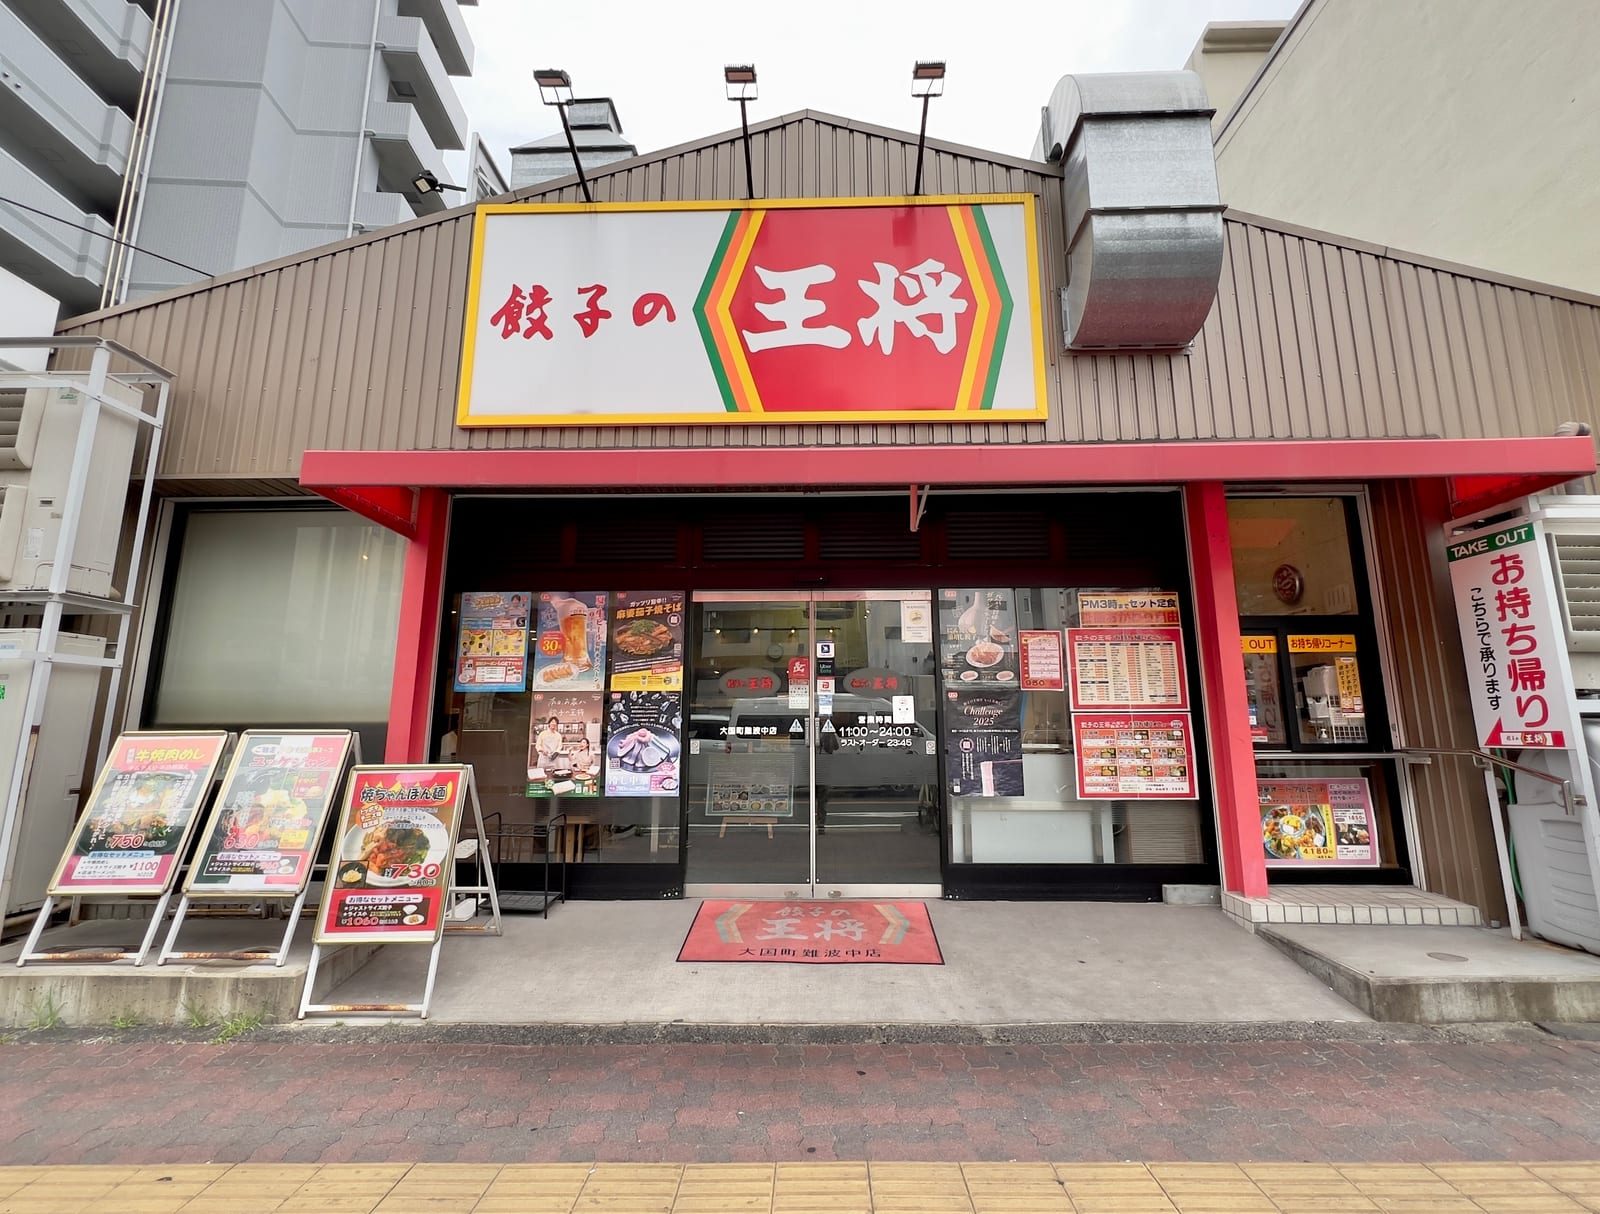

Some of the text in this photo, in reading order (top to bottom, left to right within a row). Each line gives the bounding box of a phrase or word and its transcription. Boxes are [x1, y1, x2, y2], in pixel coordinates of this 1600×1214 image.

[490, 257, 969, 356] 餃子の 王将
[1451, 527, 1529, 559] TAKE OUT
[1291, 638, 1352, 649] お持ち帰りコーナー
[1490, 553, 1550, 728] お持ち帰り
[1470, 587, 1502, 711] こちらで承ります
[963, 706, 1004, 718] Challenge
[858, 715, 893, 724] 営業時間
[973, 717, 995, 726] 2025
[720, 726, 777, 735] 大国町難波中店
[136, 748, 205, 762] 牛焼肉めし
[775, 906, 850, 918] 餃子の
[755, 918, 869, 942] 王将
[738, 947, 882, 959] 大国町難波中店
